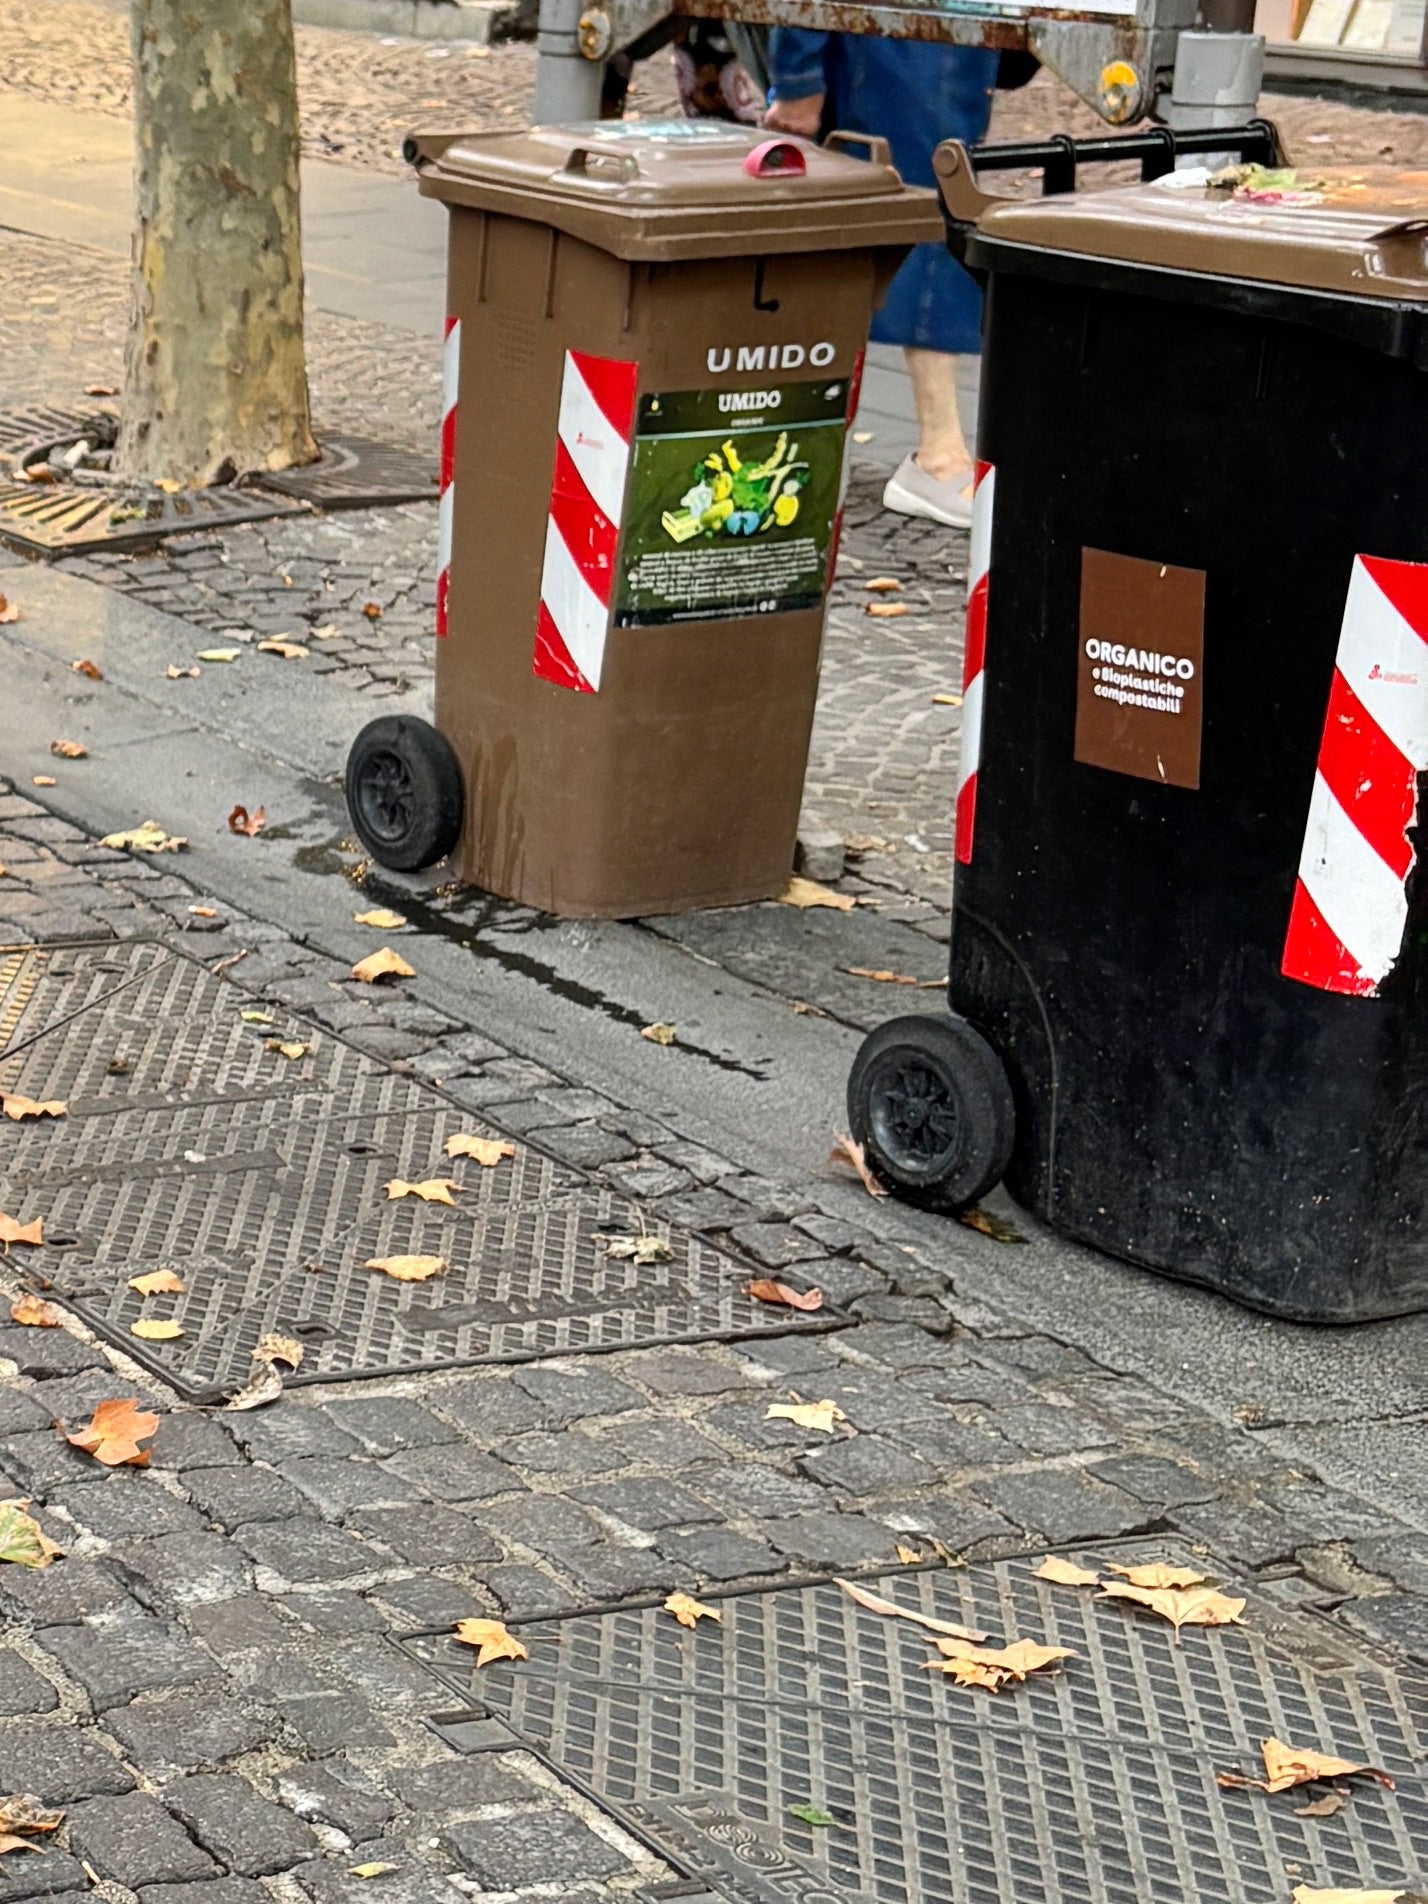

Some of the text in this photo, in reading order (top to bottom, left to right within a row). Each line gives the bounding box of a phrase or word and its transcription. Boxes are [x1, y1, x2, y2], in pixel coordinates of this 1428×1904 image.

[706, 342, 836, 373] UMIDO
[718, 390, 781, 413] UMIDO
[1085, 637, 1194, 680] ORGANICO
[1091, 666, 1185, 698] e Bioplastiche
[1093, 683, 1181, 714] compostabili
